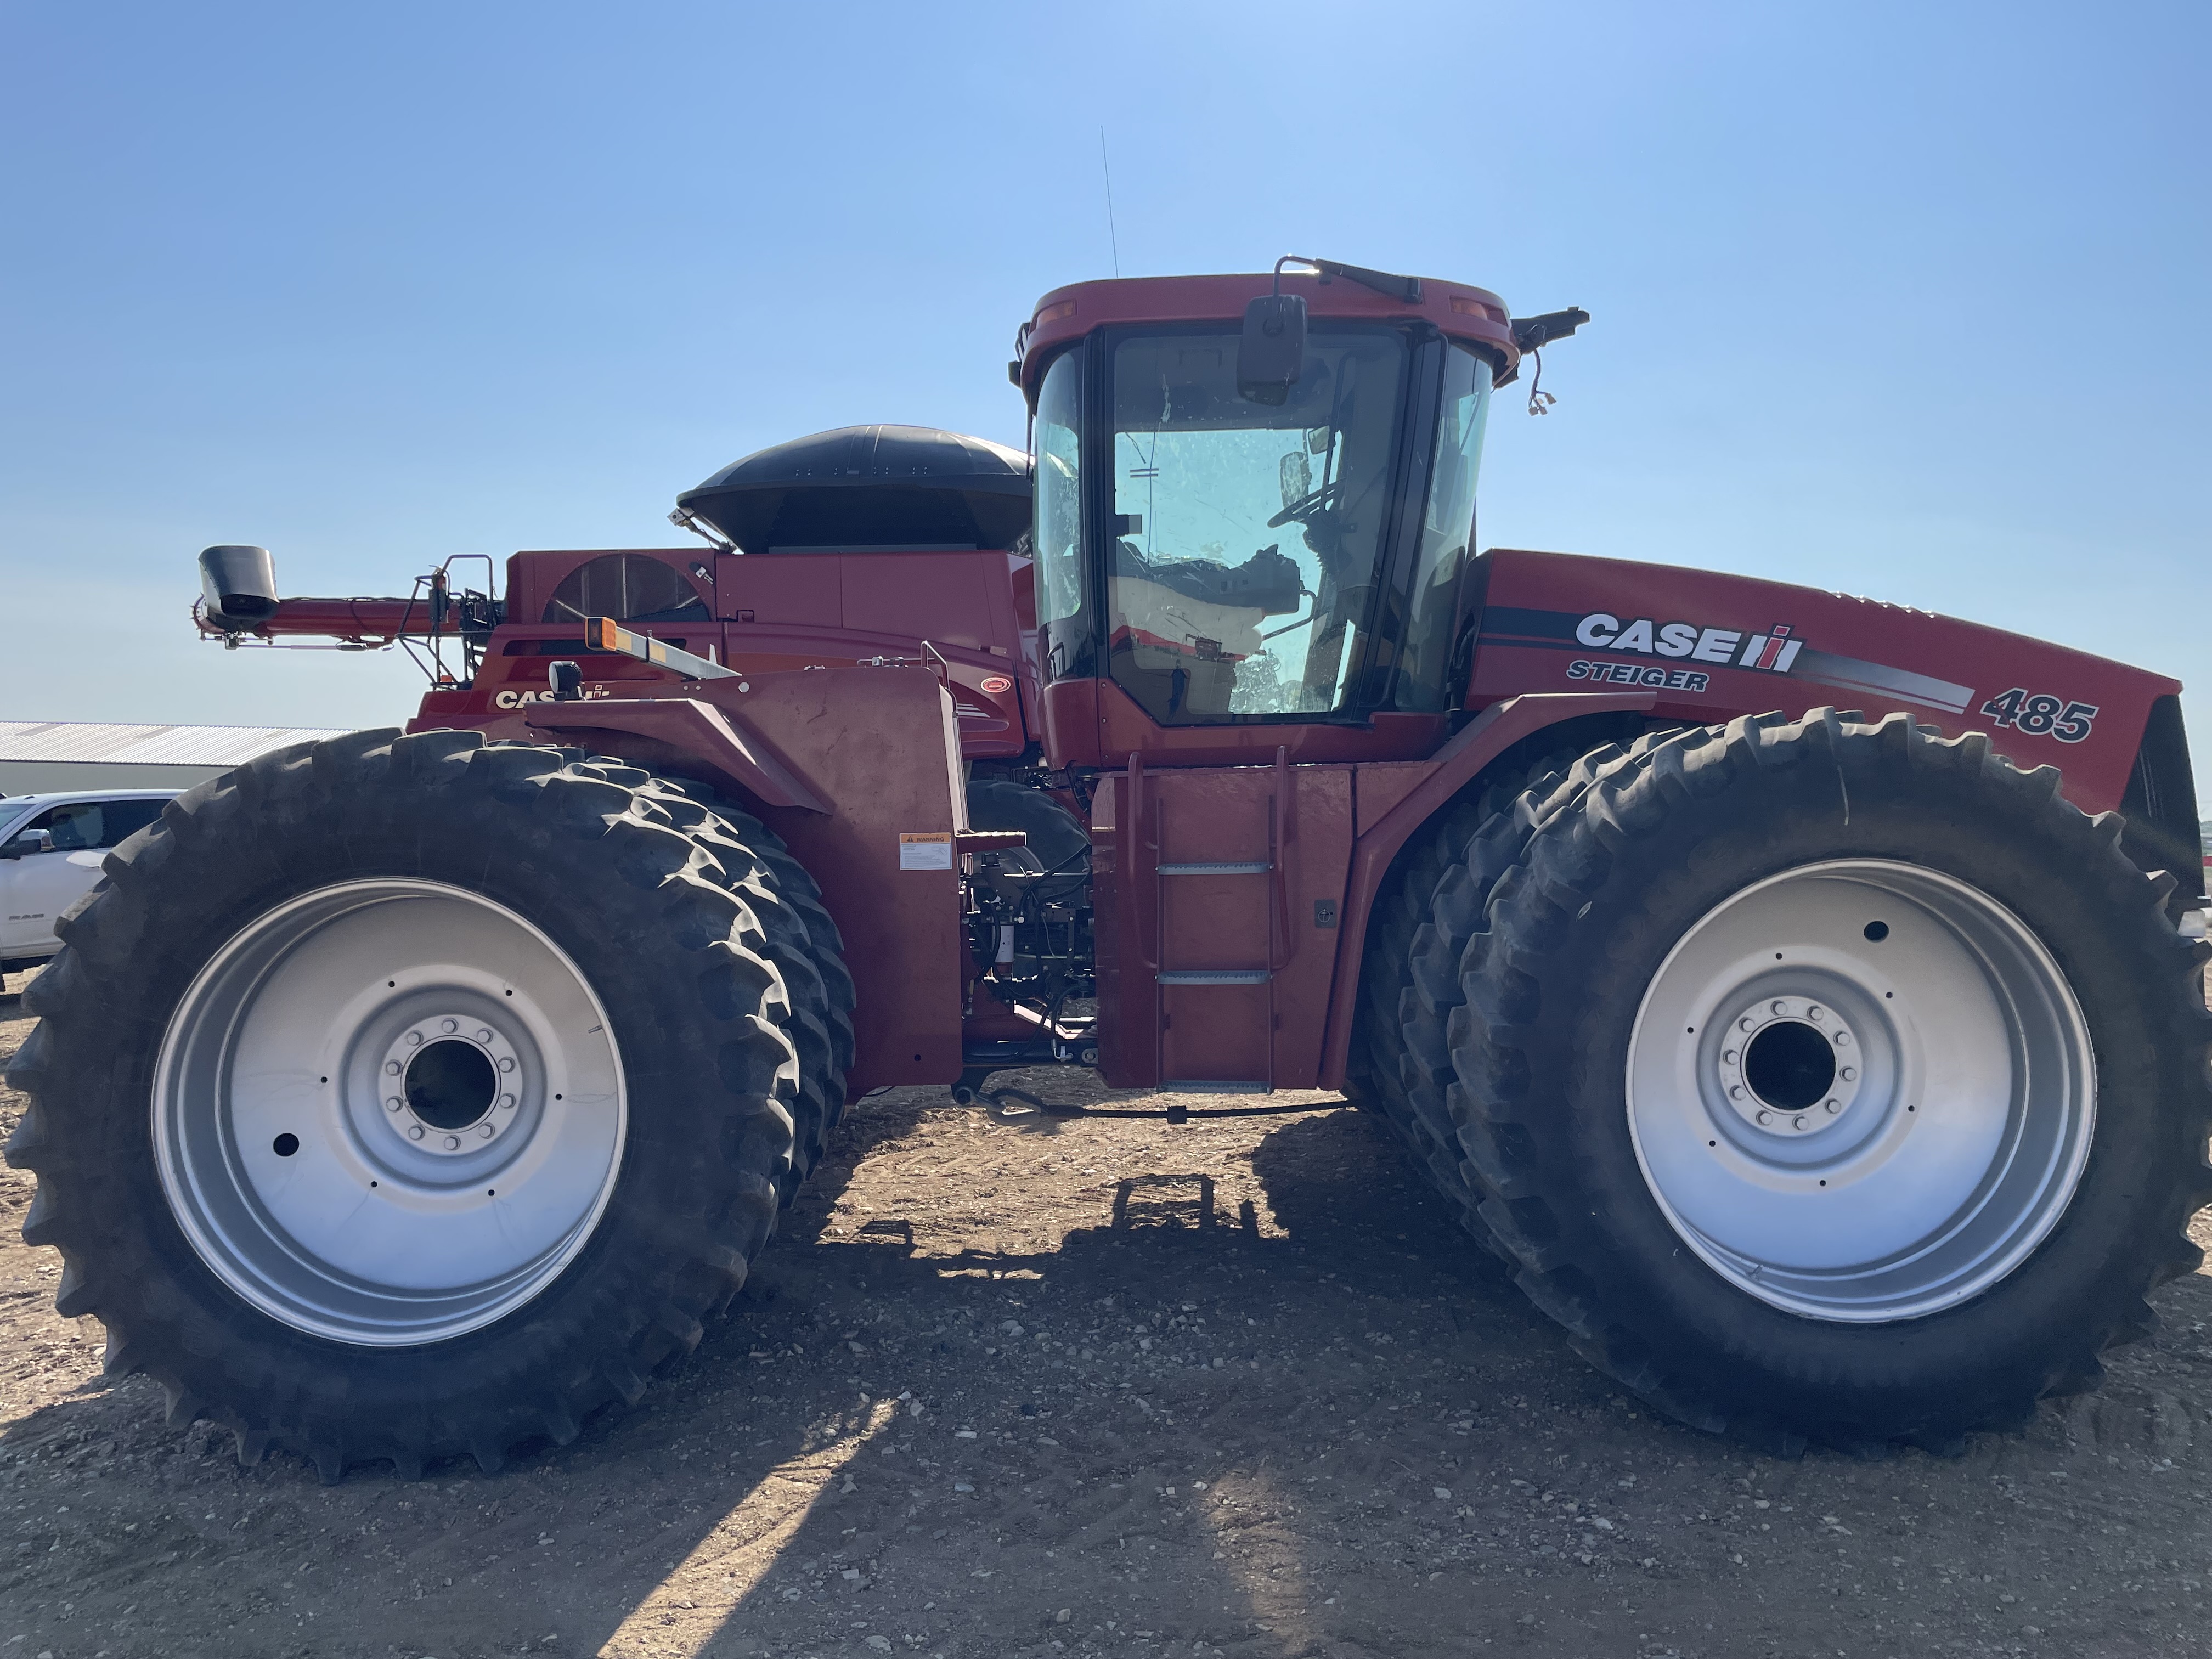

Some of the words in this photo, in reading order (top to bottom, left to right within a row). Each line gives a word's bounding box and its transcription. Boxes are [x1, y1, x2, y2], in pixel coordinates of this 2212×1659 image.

[1576, 613, 1742, 663] CASE
[1566, 659, 1710, 692] STEIGER
[1979, 687, 2100, 744] 485
